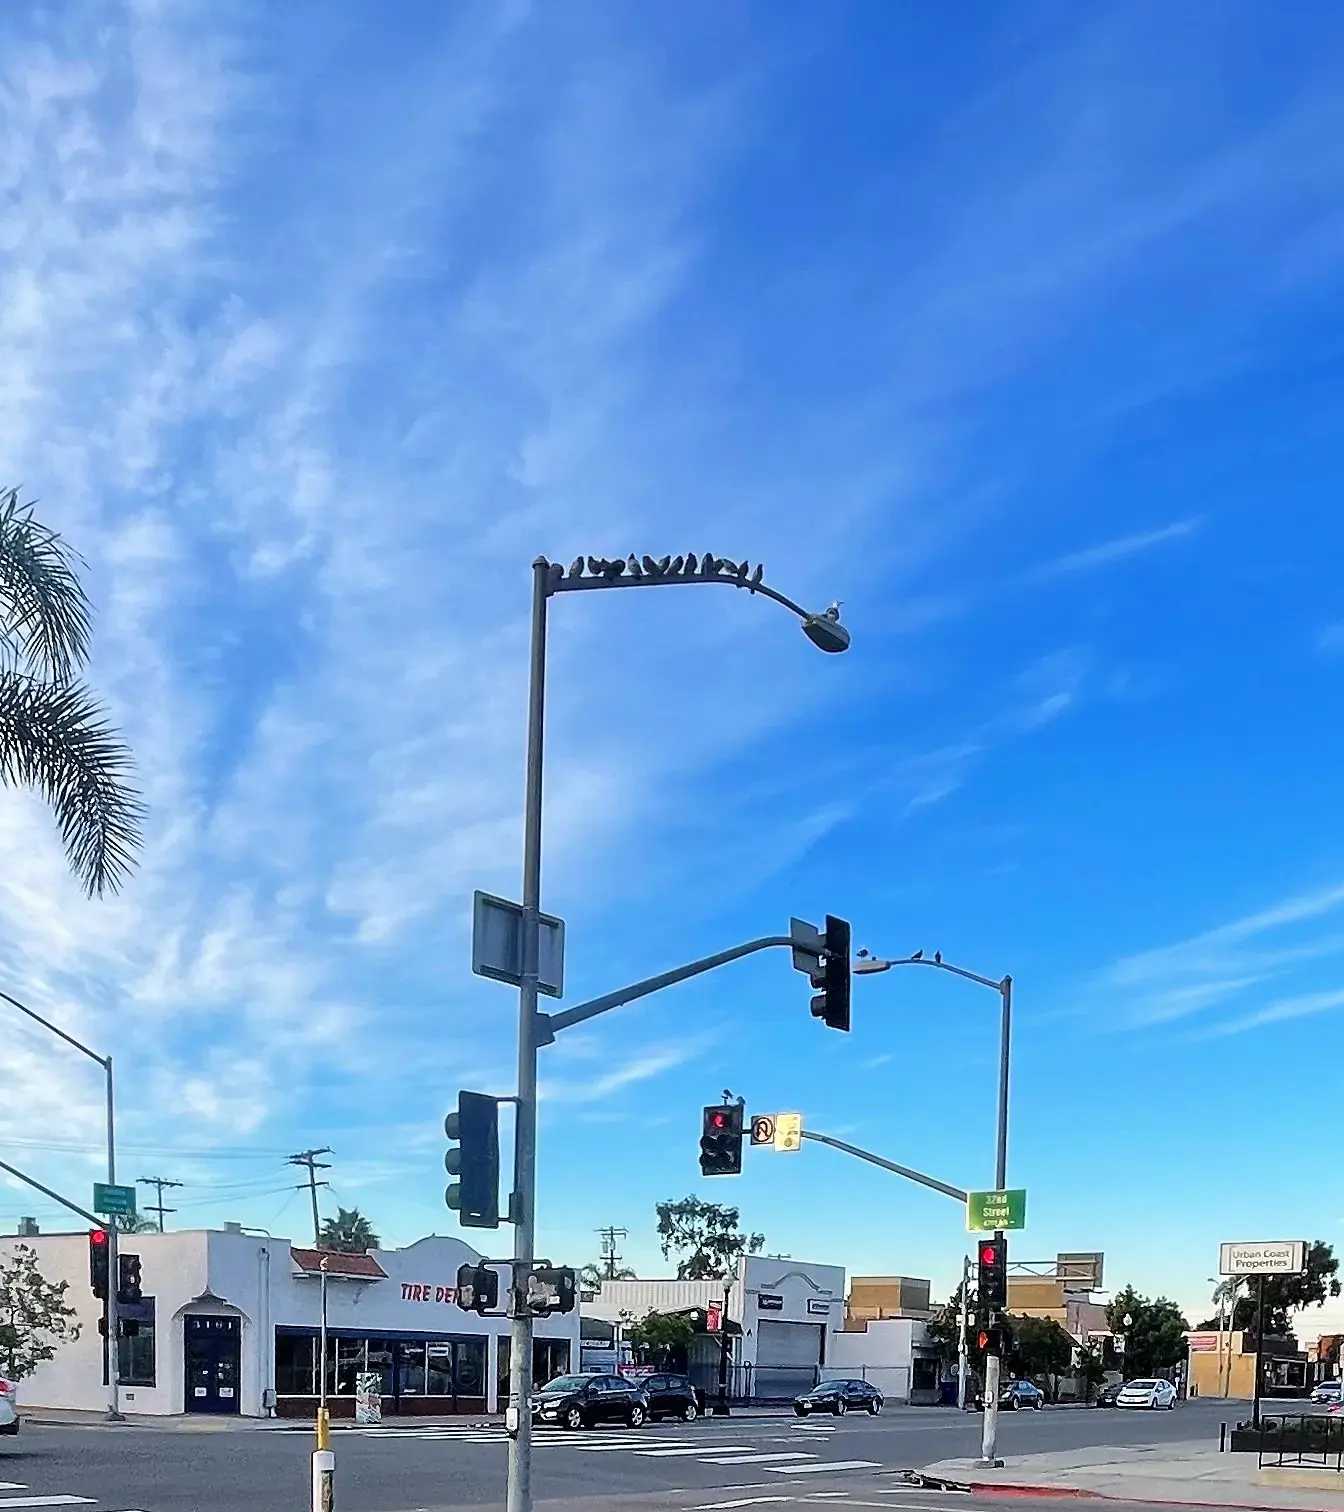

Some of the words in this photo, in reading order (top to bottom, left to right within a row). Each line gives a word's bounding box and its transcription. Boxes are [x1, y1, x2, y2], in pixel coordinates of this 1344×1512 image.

[1232, 1250, 1261, 1259] Urban
[1263, 1249, 1290, 1258] Coast
[1235, 1259, 1288, 1269] Properties
[400, 1283, 432, 1301] TIRE
